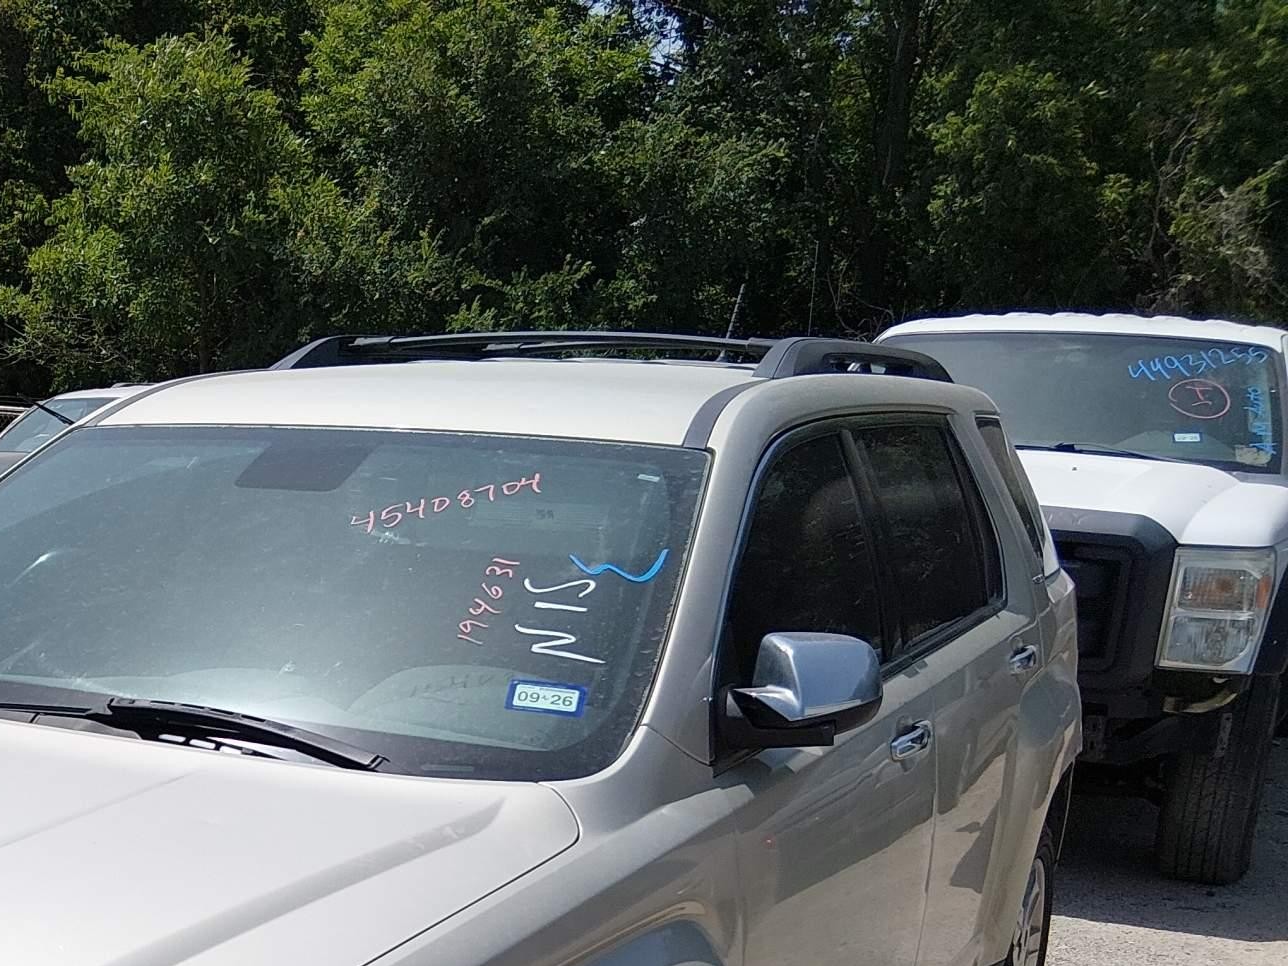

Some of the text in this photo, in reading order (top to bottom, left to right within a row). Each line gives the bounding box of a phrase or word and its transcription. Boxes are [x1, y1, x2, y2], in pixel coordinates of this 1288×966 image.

[1127, 346, 1269, 381] 44931255
[350, 472, 542, 534] 45408704
[457, 557, 520, 646] 194631
